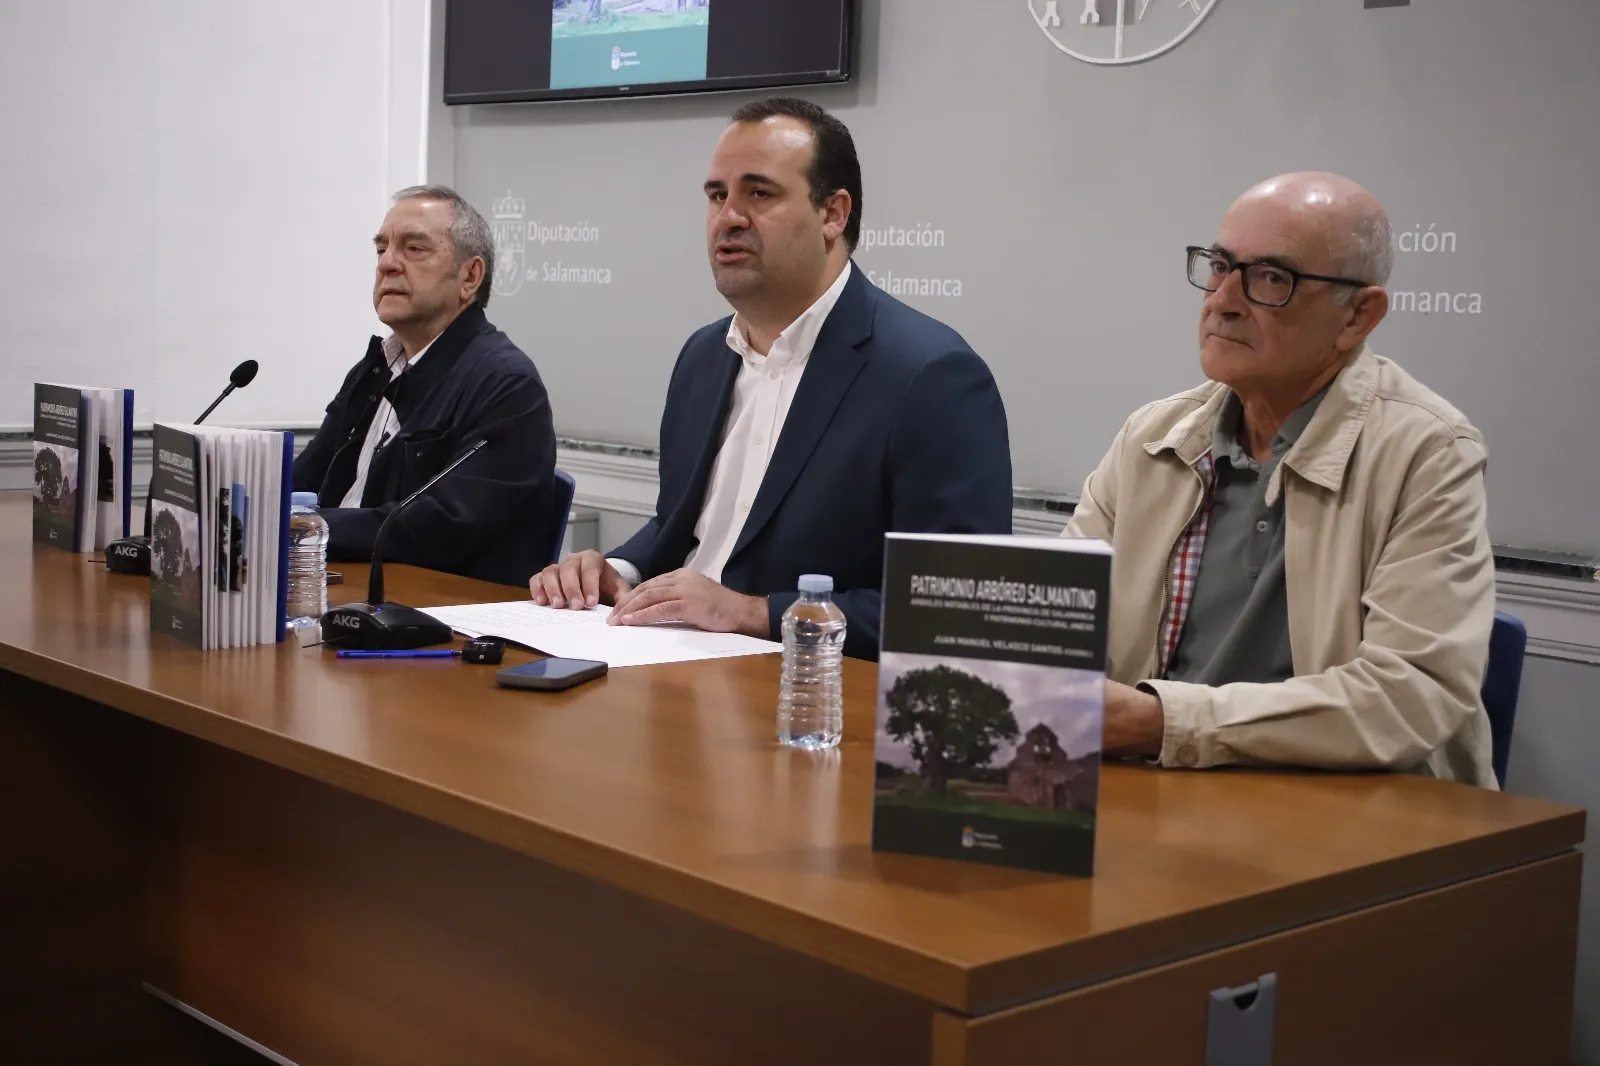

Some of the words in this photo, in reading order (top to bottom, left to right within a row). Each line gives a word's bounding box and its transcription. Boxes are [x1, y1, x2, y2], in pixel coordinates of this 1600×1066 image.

[527, 220, 599, 246] Diputación
[860, 222, 945, 252] iputación
[542, 260, 612, 284] Salamanca
[1391, 291, 1482, 314] manca
[114, 545, 138, 558] AKG
[910, 574, 975, 600] PATRIMONIO
[975, 575, 1026, 605] ARBÓREO
[1026, 583, 1096, 611] SALMANTINO
[332, 613, 360, 629] AKG
